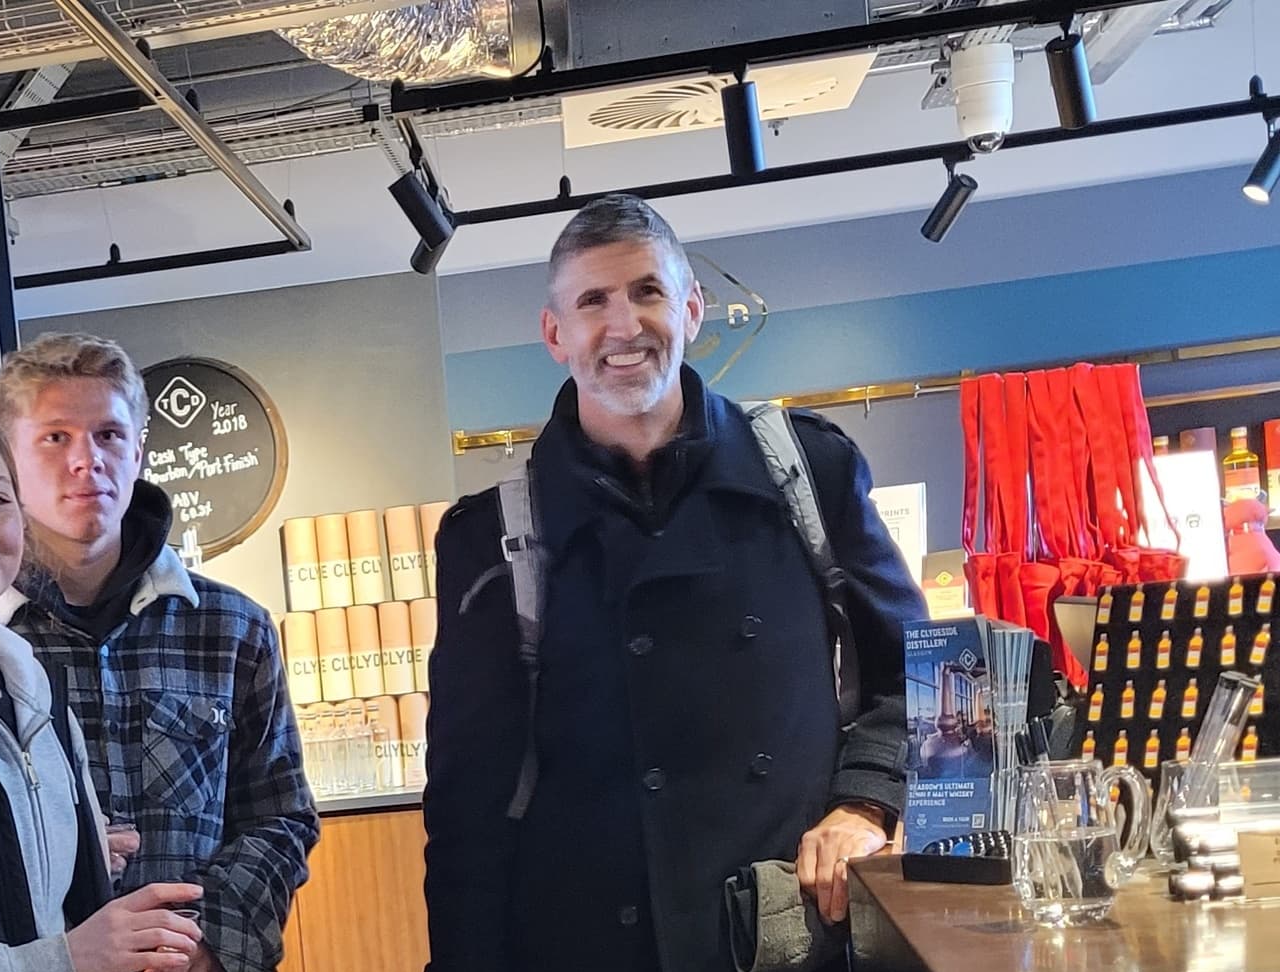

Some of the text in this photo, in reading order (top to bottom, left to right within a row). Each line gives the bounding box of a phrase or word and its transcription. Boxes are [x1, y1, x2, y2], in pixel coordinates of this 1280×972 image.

[211, 401, 238, 420] Year
[212, 414, 248, 435] 2018
[906, 630, 919, 639] THE
[906, 638, 948, 650] DISTILLERY
